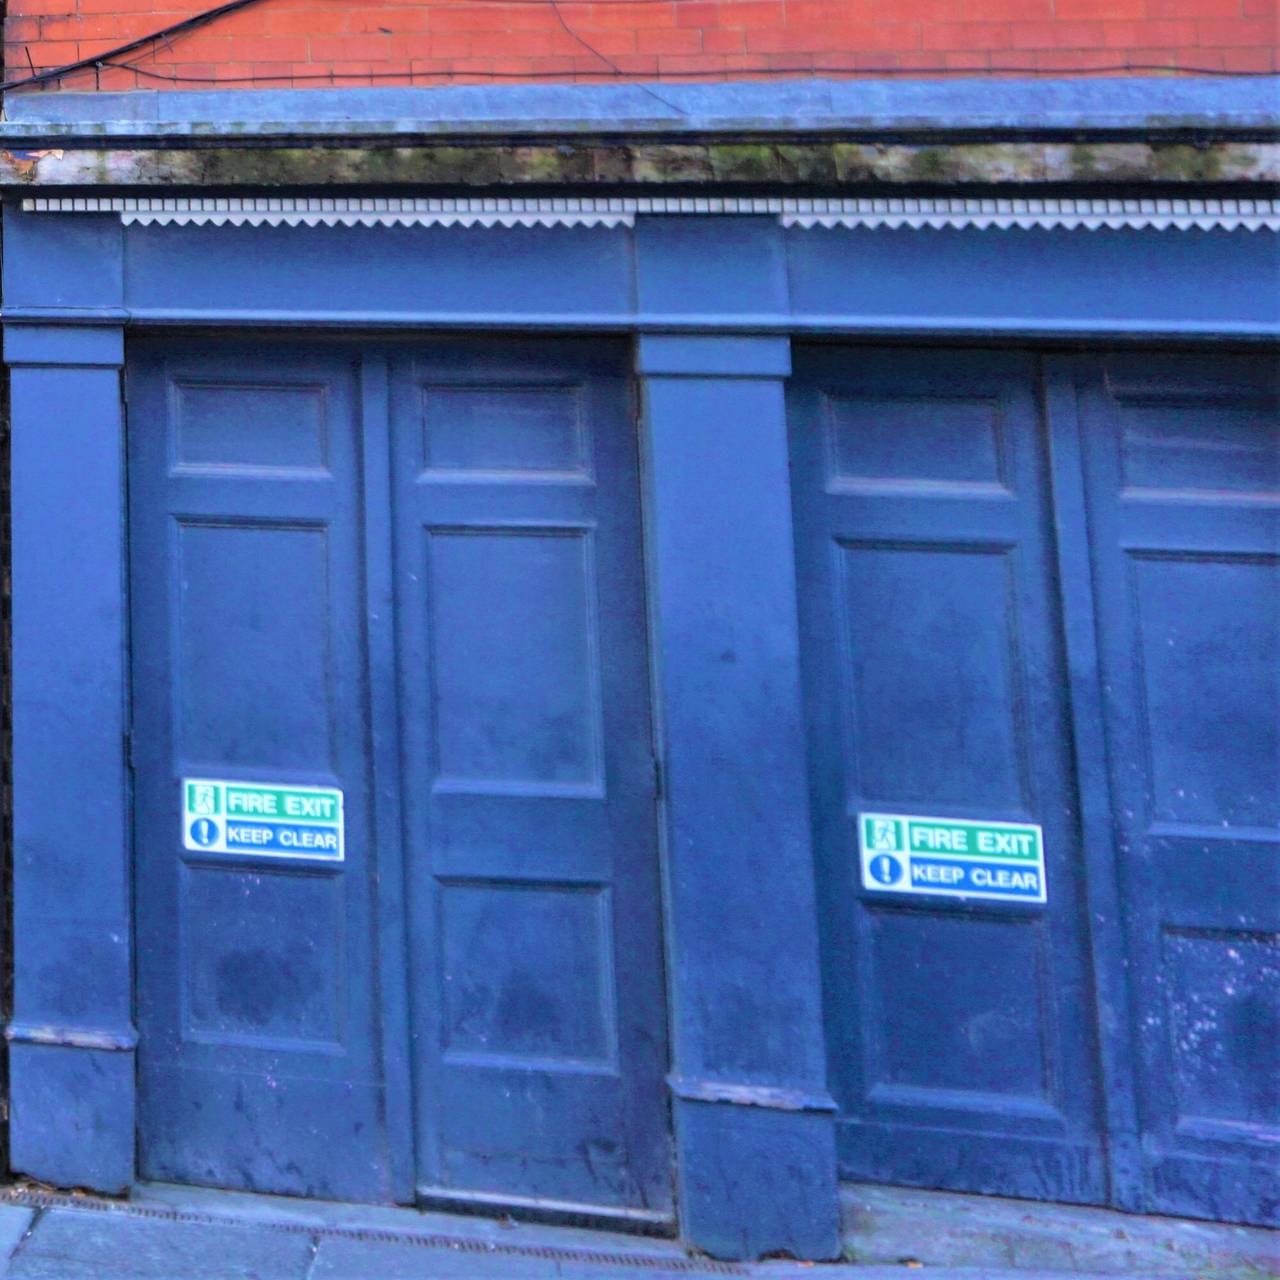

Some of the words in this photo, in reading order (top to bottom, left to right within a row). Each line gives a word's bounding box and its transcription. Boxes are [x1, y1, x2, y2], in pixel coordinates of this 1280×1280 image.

[228, 792, 277, 814] FIRE
[286, 796, 335, 818] EXIT
[228, 827, 273, 845] KEEP
[279, 831, 337, 849] CLEAR
[912, 826, 968, 851] FIRE
[976, 831, 1033, 855] EXIT
[912, 863, 965, 884] KEEP
[971, 867, 1037, 890] CLEAR
